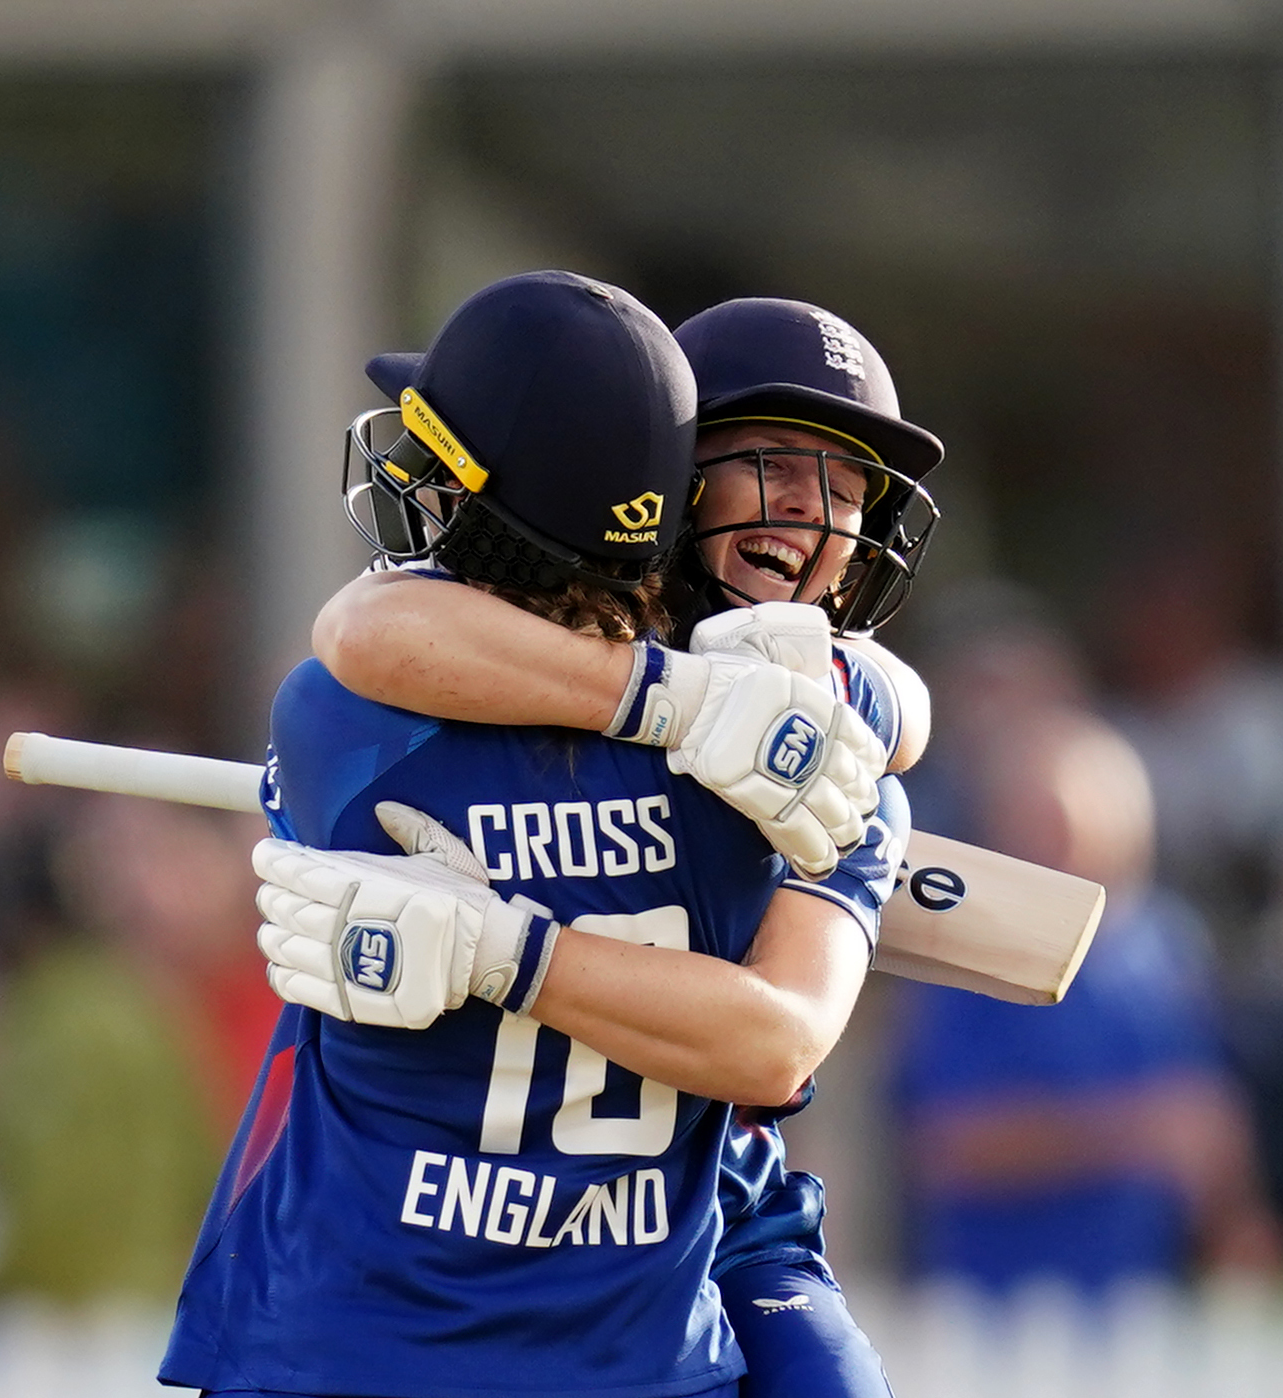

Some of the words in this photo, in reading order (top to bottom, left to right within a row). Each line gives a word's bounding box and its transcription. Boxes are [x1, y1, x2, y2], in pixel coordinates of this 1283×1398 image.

[414, 406, 456, 456] MASURI
[604, 529, 659, 545] MASURI
[651, 714, 667, 738] Play
[773, 716, 818, 778] SM
[468, 794, 676, 881] CROSS
[894, 858, 968, 914] e
[357, 929, 389, 989] SM
[400, 1149, 670, 1248] ENGLAND
